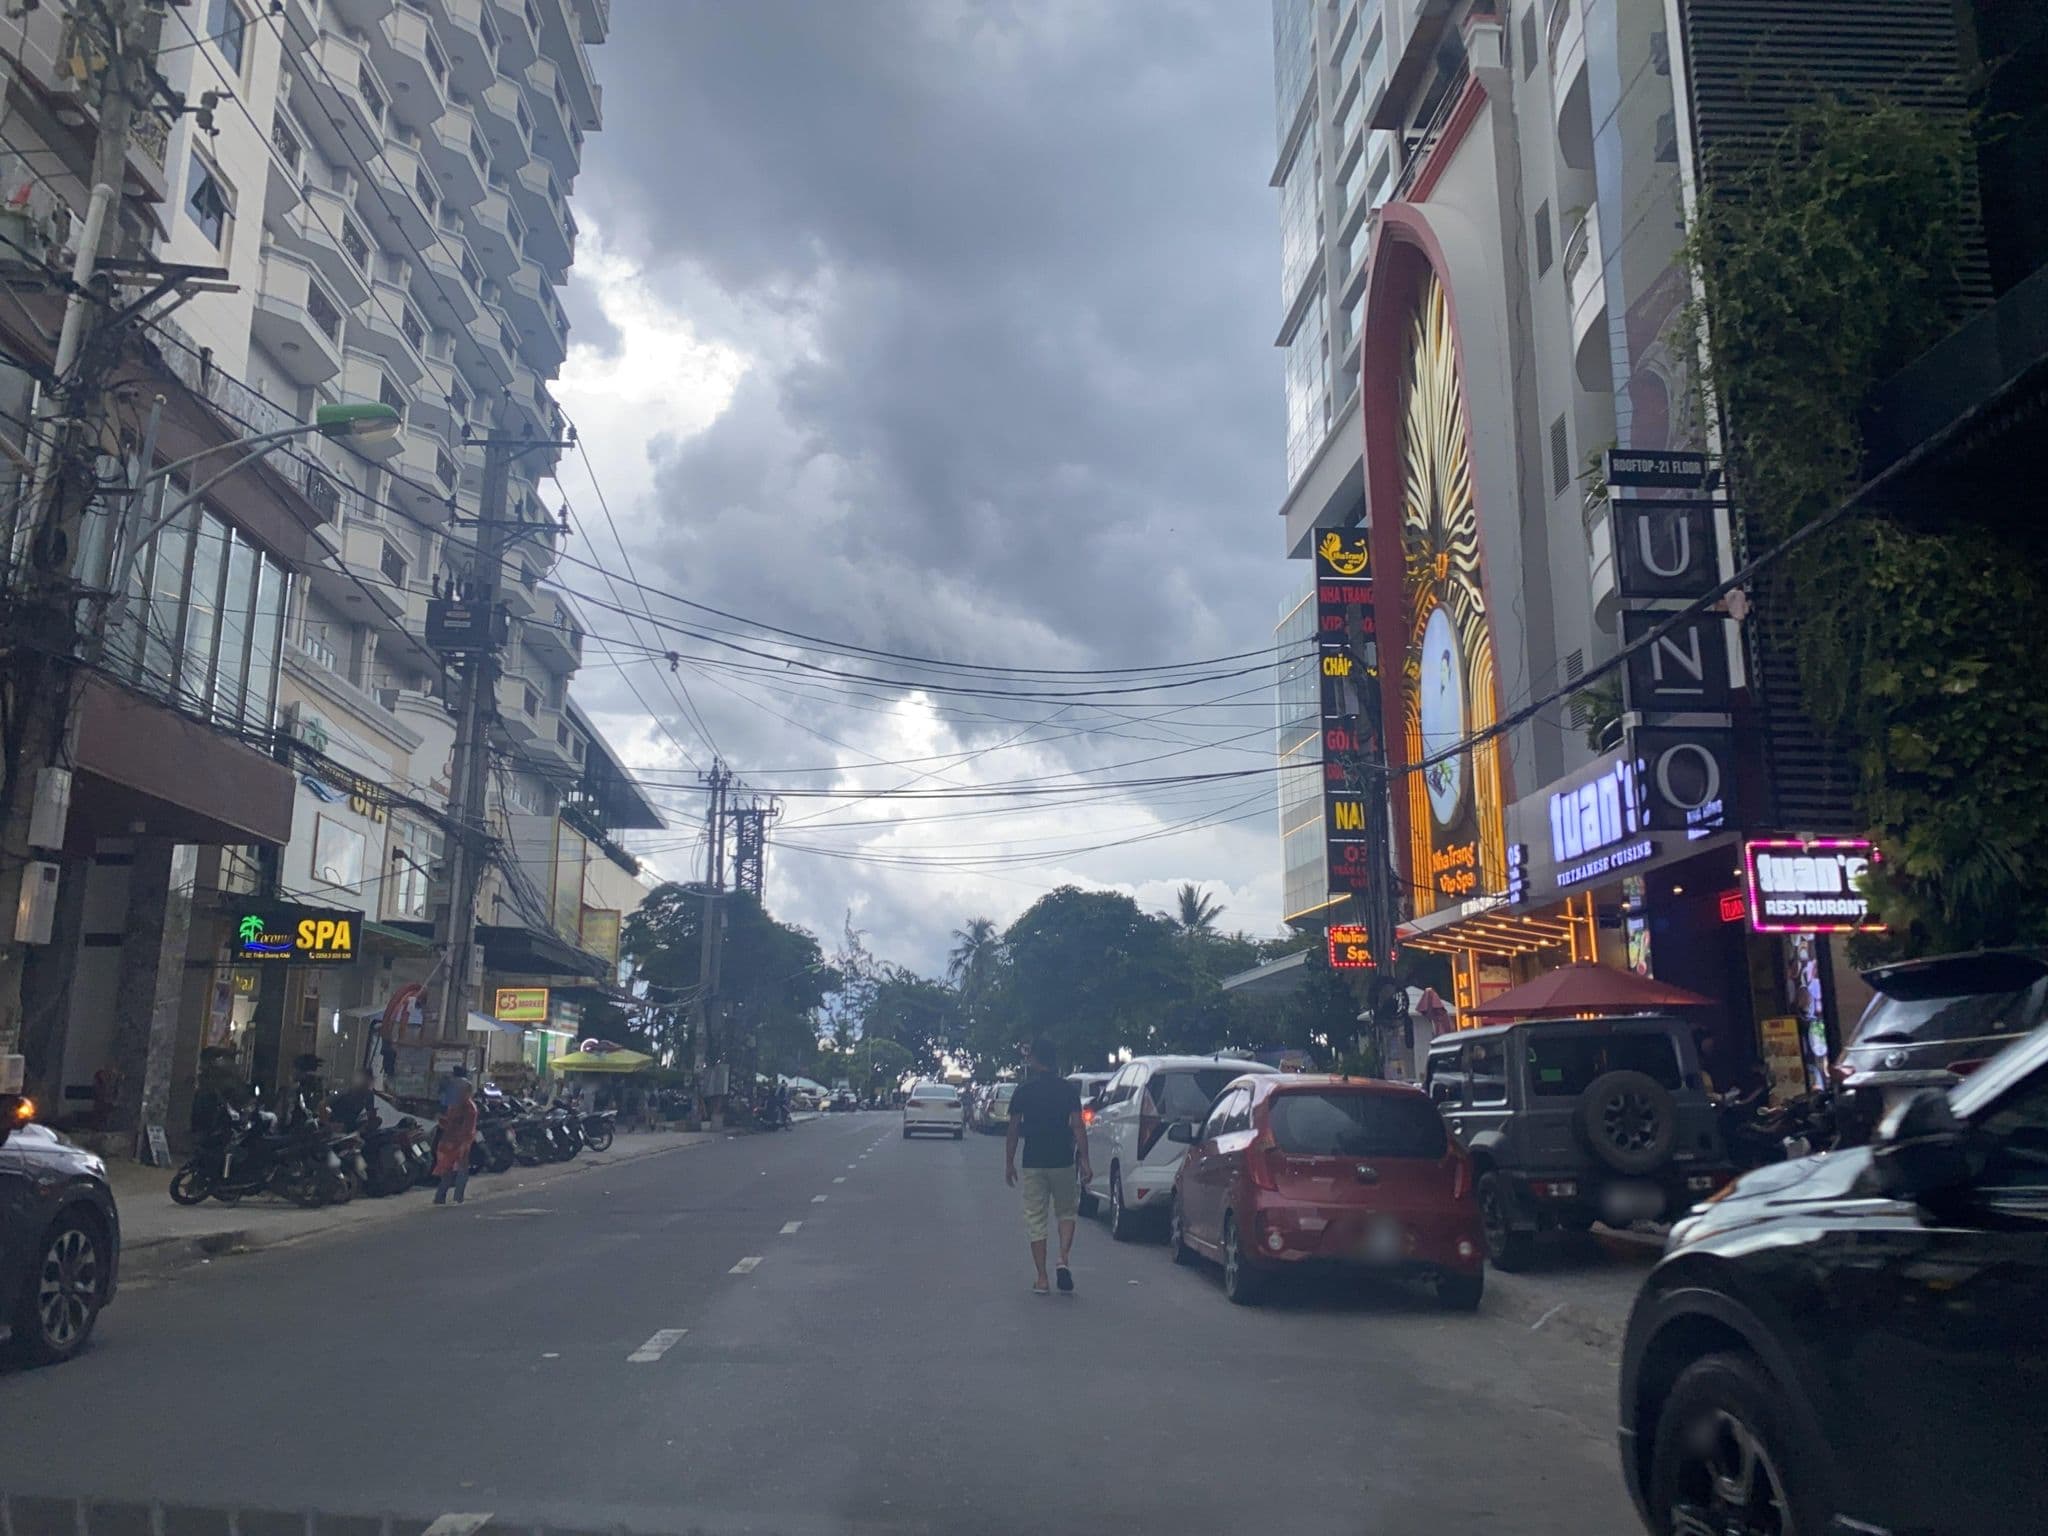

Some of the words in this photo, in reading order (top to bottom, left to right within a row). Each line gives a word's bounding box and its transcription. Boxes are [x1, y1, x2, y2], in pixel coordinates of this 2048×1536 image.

[1672, 460, 1702, 475] FLOOR
[1319, 586, 1340, 604] NHA
[1556, 855, 1610, 888] VIETNAMESE
[1610, 839, 1653, 869] CUISINE
[1765, 899, 1869, 916] RESTAURANT
[295, 919, 352, 951] SPA
